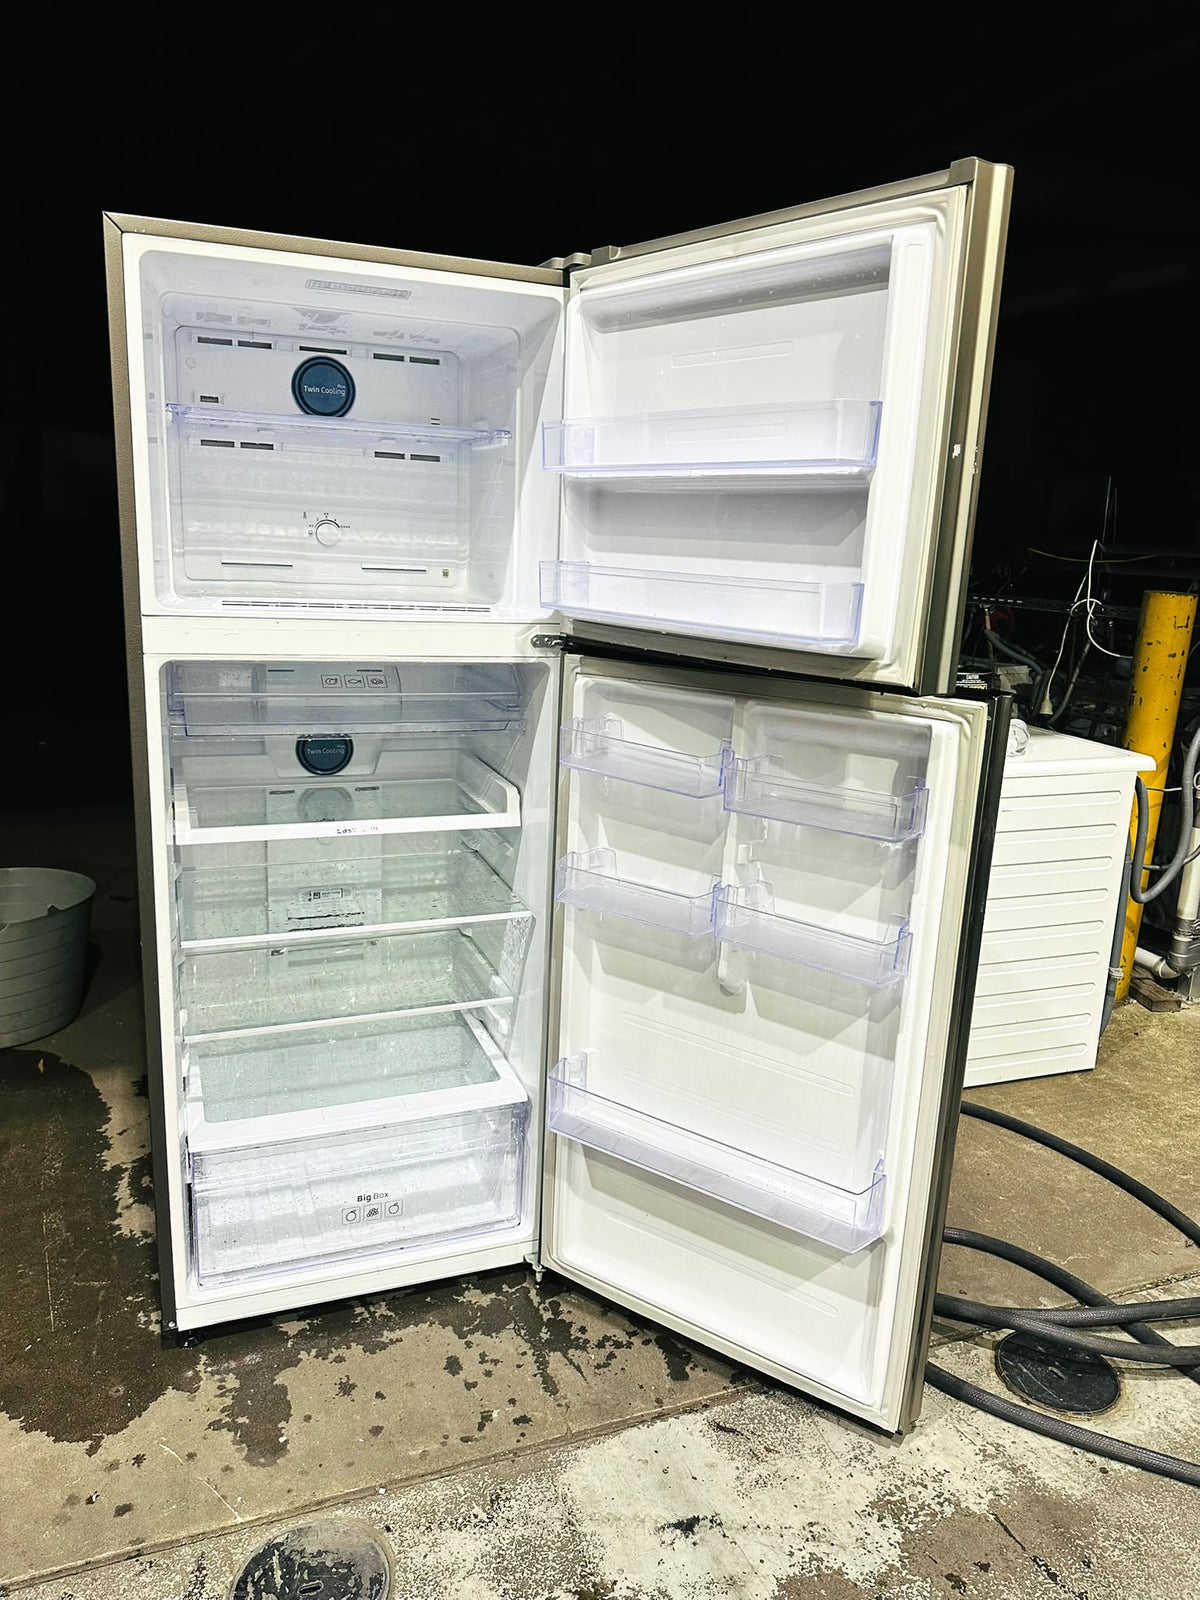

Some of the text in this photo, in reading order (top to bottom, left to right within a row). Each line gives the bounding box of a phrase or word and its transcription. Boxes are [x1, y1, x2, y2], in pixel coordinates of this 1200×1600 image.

[304, 385, 346, 397] Twin Cooling
[323, 747, 345, 755] Cooling
[357, 1192, 389, 1203] Big Box
